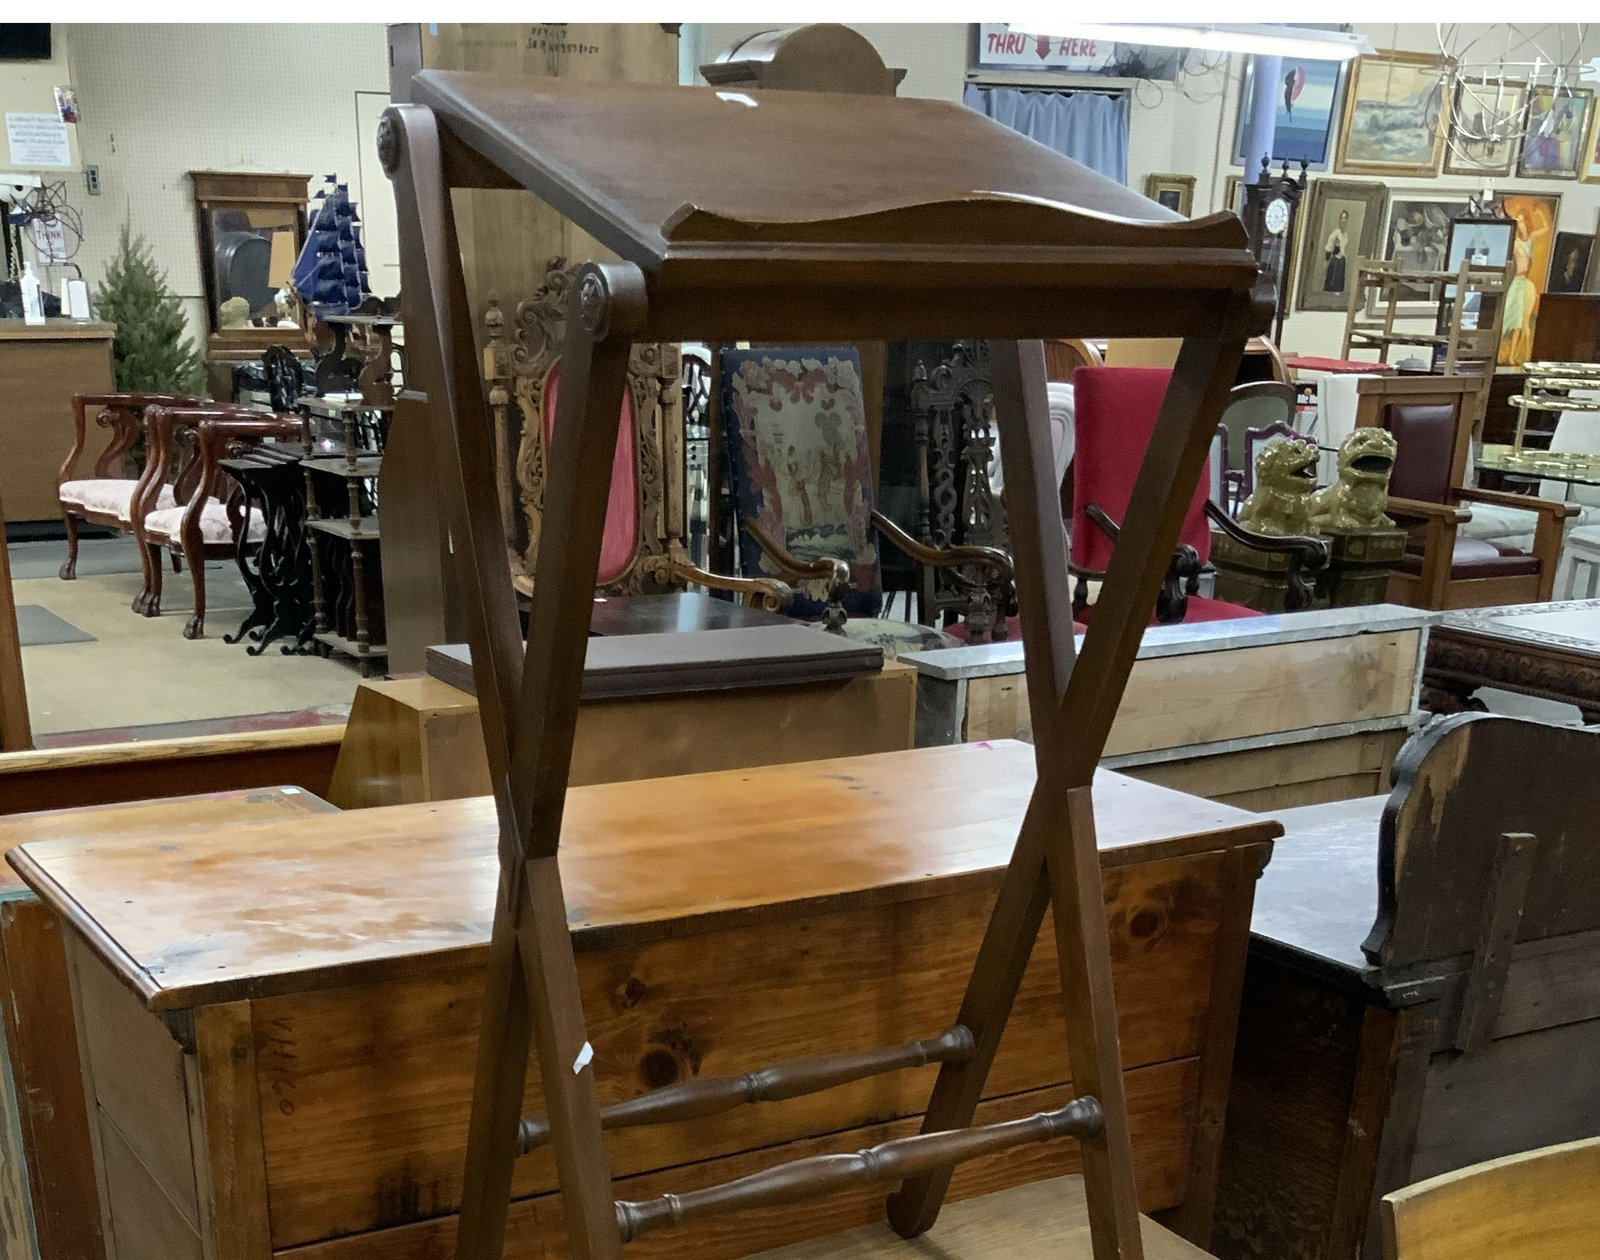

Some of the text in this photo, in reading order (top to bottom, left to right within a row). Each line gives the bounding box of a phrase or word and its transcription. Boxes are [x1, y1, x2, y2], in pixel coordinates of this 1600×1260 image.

[987, 33, 1096, 57] THRU HERE
[36, 229, 64, 241] THINK
